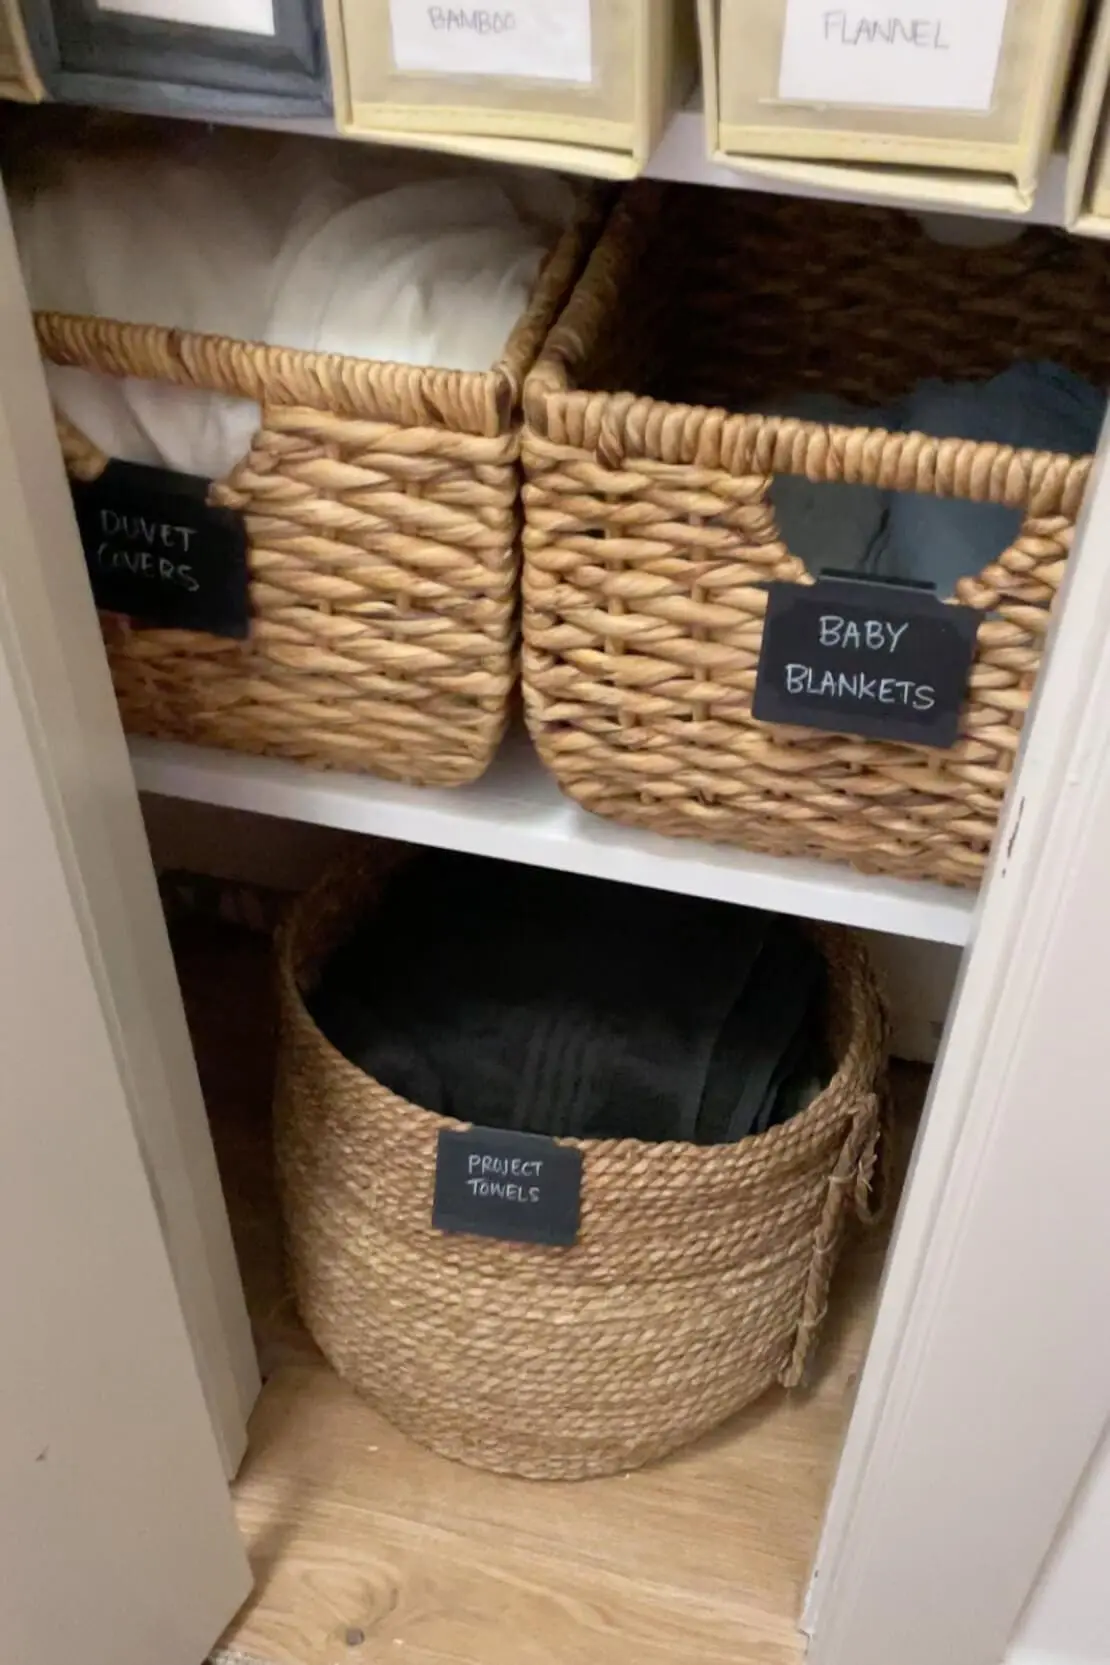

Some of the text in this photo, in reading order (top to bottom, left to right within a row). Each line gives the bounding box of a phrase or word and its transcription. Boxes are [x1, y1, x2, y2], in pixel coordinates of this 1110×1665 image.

[428, 6, 516, 34] BAMBOO
[823, 9, 950, 49] FLANNEL
[100, 509, 198, 552] DUVET
[819, 615, 908, 653] BABY
[785, 663, 936, 710] BLANKETS
[467, 1154, 543, 1177] PROJECT
[465, 1177, 541, 1203] TOWELS
